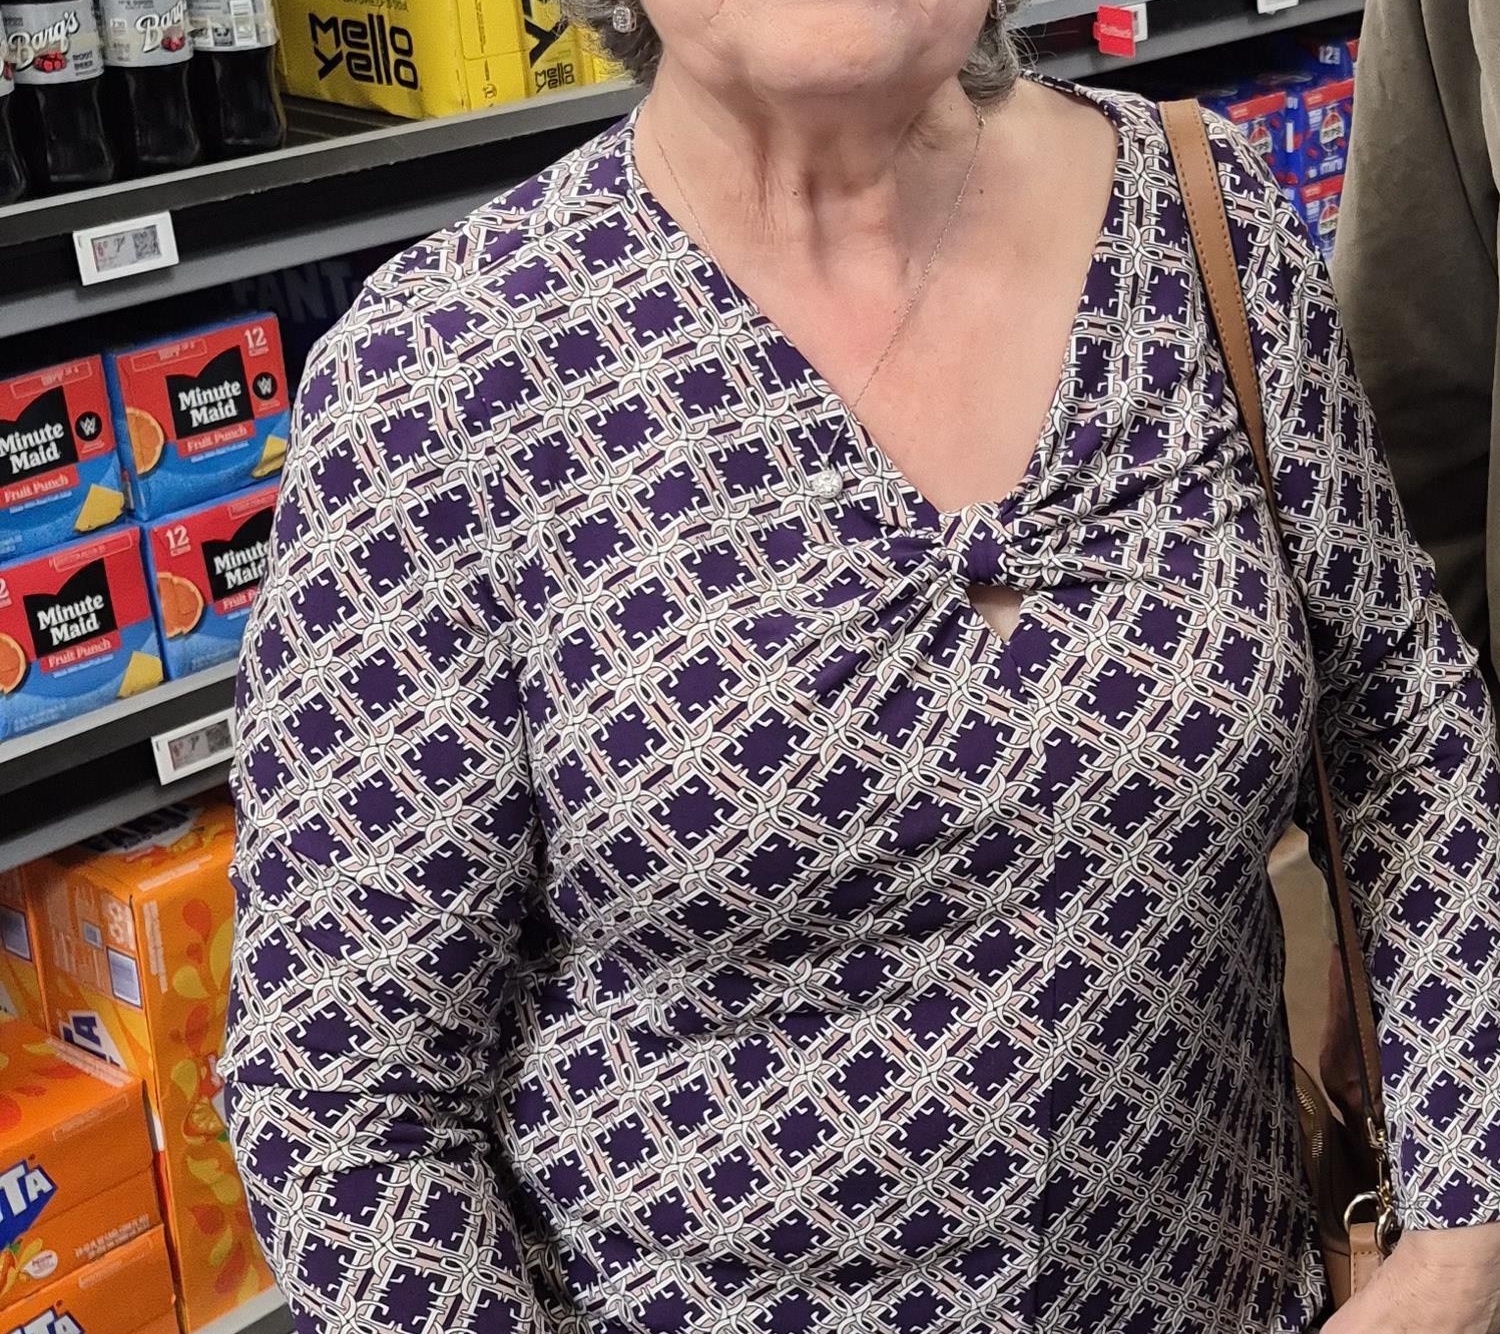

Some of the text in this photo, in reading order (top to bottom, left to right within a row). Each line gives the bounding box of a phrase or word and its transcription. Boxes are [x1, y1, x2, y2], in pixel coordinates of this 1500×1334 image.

[8, 10, 79, 71] Barq's
[308, 12, 414, 60] Mello
[244, 326, 266, 350] 12
[178, 378, 242, 412] Minute
[190, 399, 239, 428] Maid
[0, 420, 65, 458] Minute
[187, 424, 248, 453] Fruit Punch
[9, 443, 62, 475] Maid
[3, 473, 70, 503] Fruit Punch
[166, 525, 190, 551] 12
[37, 593, 105, 631] Minute
[222, 591, 248, 611] Fruit
[49, 613, 101, 647] Maid
[48, 638, 112, 668] Fruit Punch
